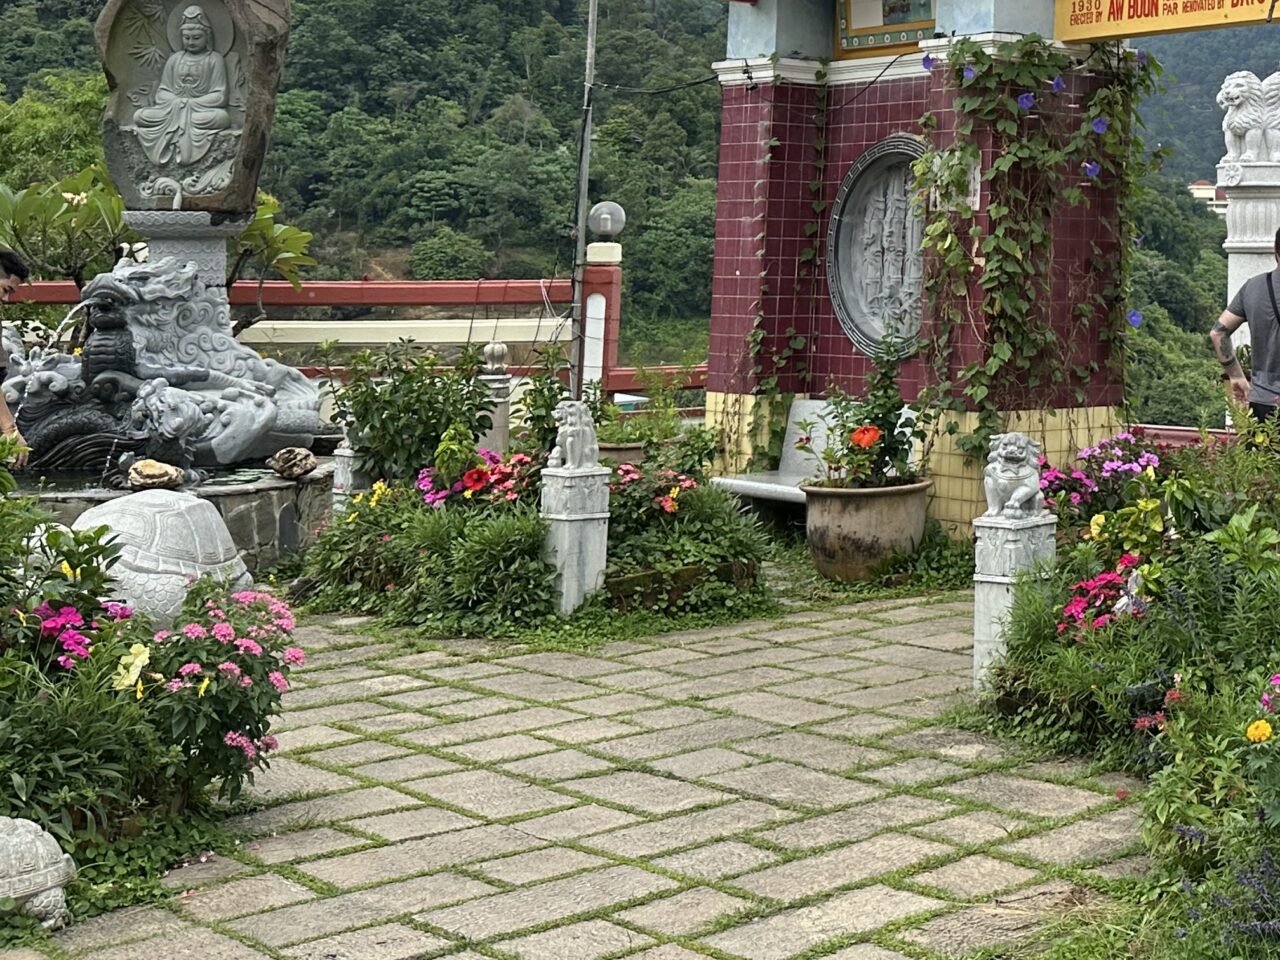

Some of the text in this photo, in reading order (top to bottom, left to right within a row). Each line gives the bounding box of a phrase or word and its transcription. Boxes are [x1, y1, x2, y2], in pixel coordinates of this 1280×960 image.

[1162, 1, 1178, 16] PAR
[1070, 10, 1103, 26] ERECTED BY
